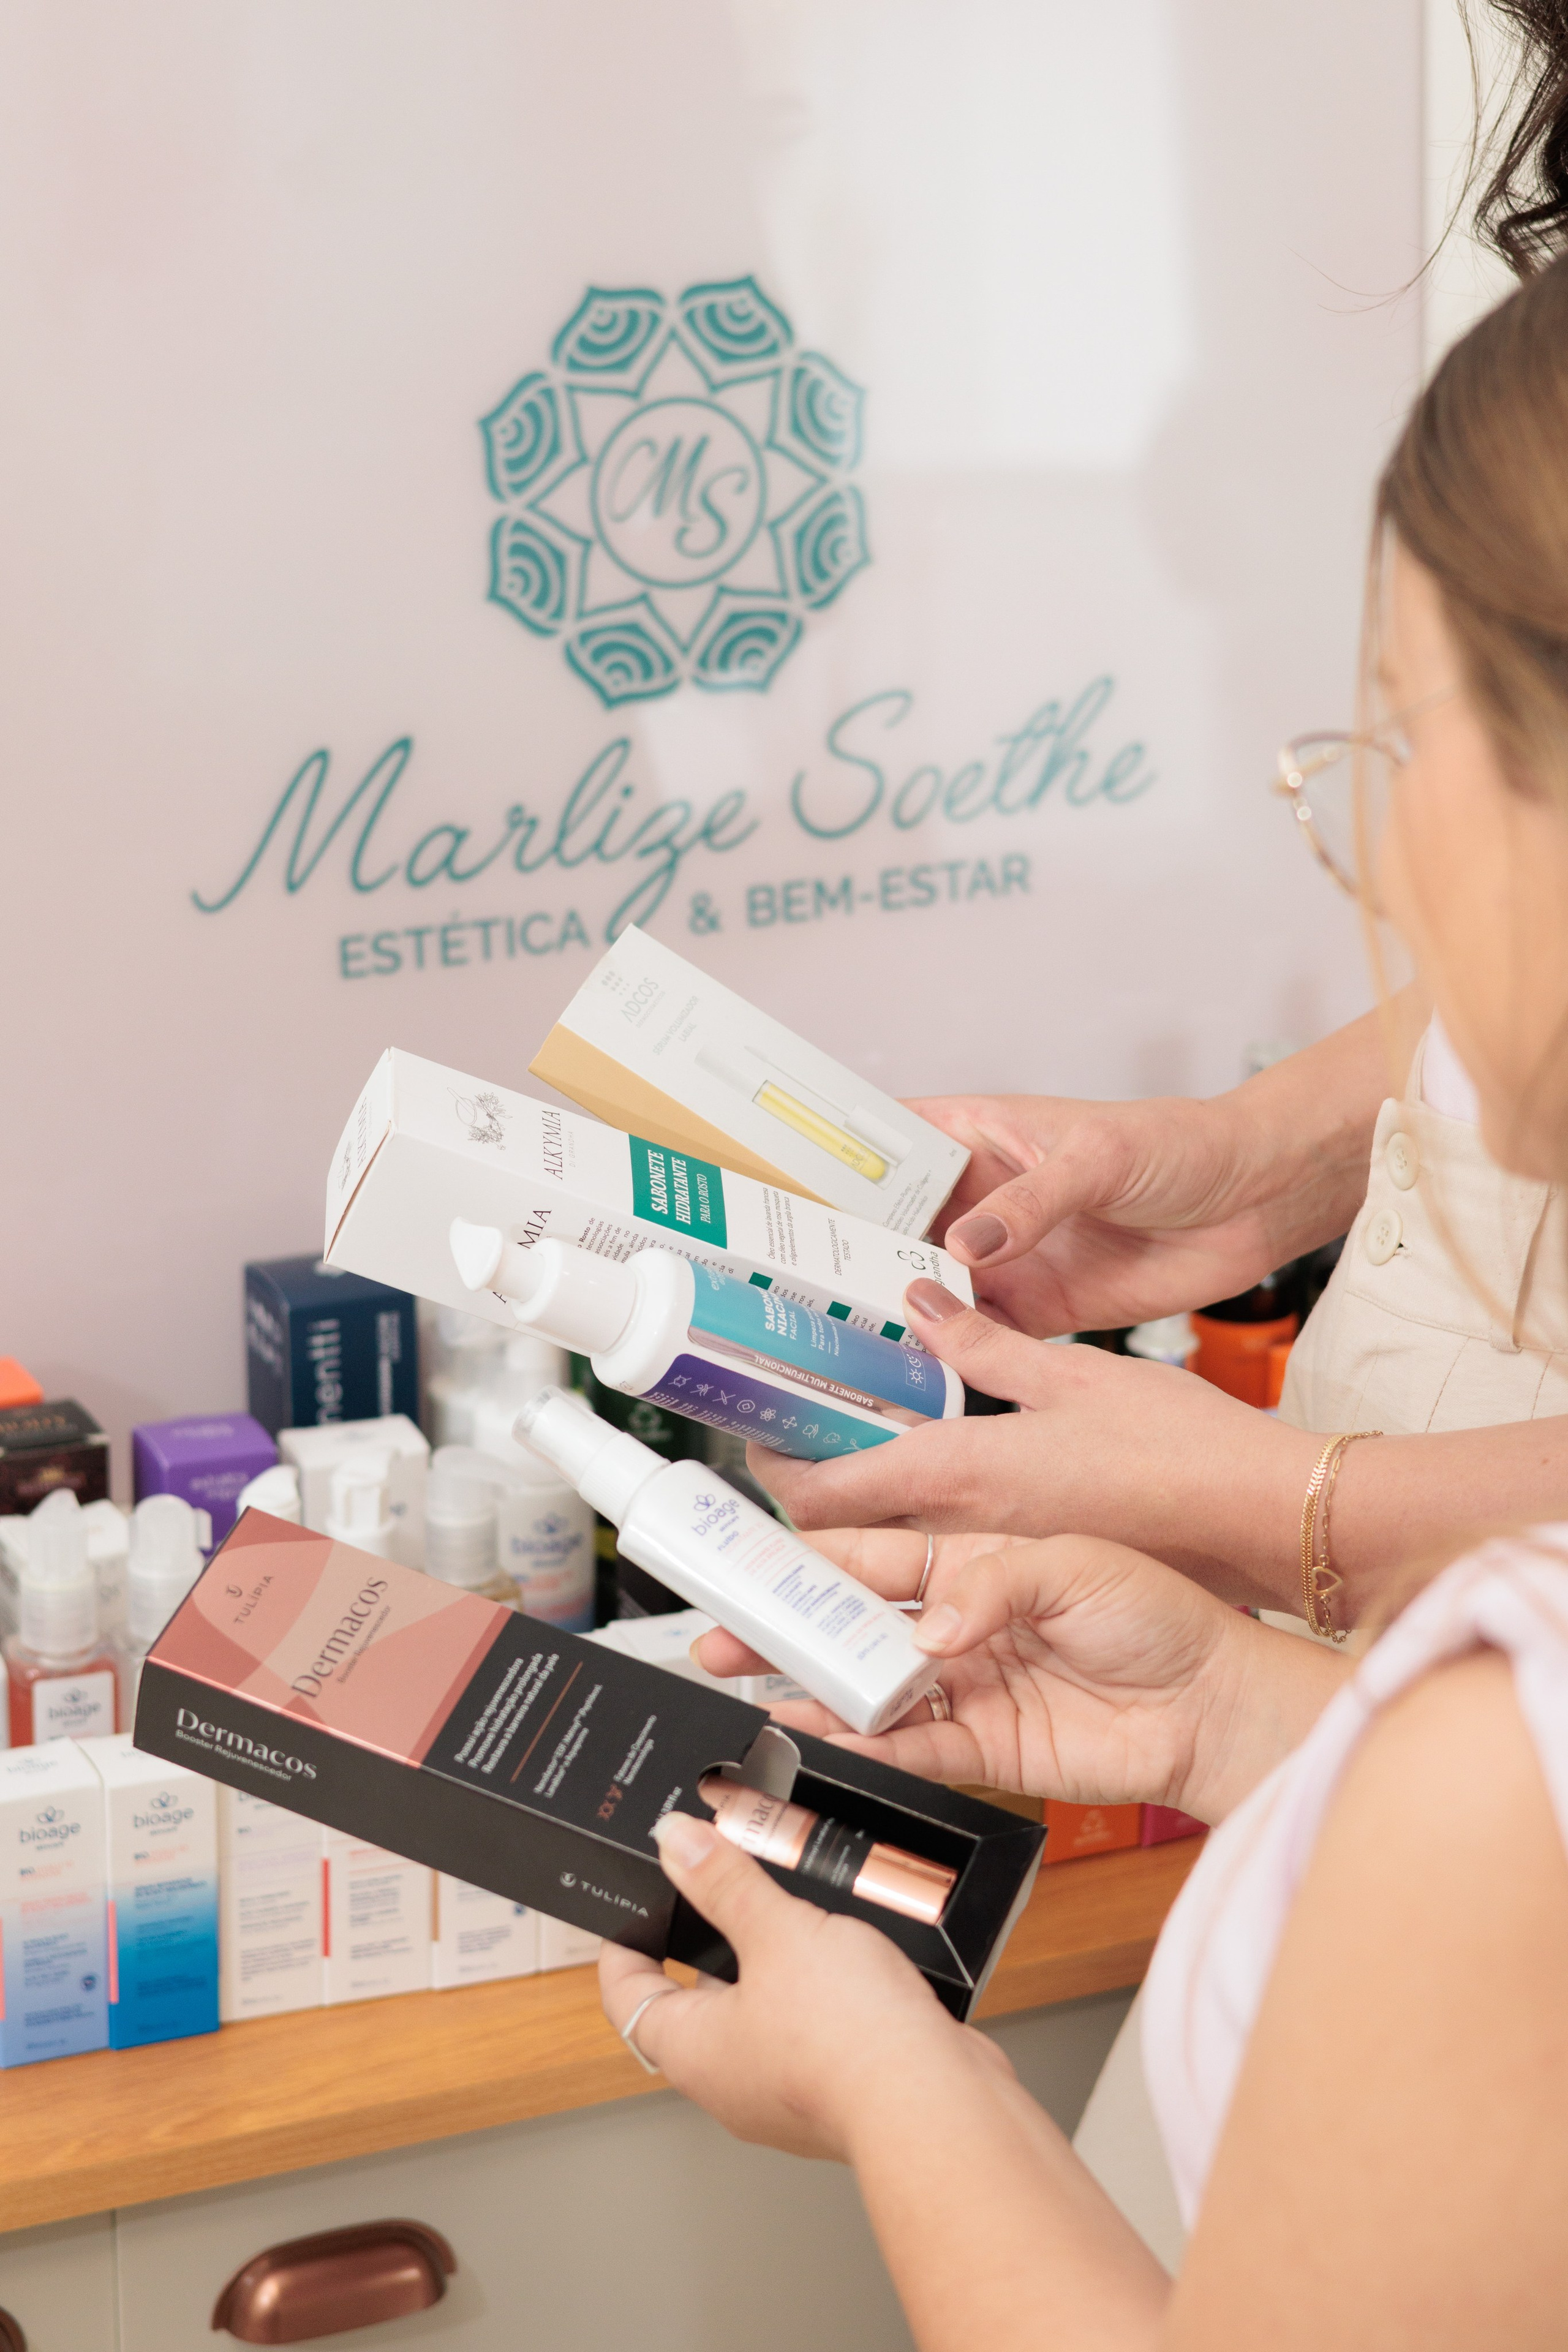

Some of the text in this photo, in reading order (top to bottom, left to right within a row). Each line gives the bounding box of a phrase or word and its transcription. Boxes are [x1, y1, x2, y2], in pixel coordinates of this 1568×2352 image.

[190, 676, 1160, 946] Marlize Soethe
[339, 852, 1033, 980] ESTÉTICA & BEM-ESTAR
[620, 977, 659, 1023] ADCOS
[652, 995, 700, 1056] SÉRUM VOLUMIZADOR
[677, 1022, 698, 1042] LABIAL
[541, 1110, 563, 1180] ALKYMIA
[570, 1159, 576, 1168] DI
[647, 1149, 668, 1215] SABONETE
[671, 1156, 691, 1225] HIDRATANTE
[696, 1174, 708, 1197] ROSTO
[900, 1194, 917, 1216] Volumizador
[916, 1172, 931, 1189] Colágeno
[699, 1204, 710, 1224] PARA
[764, 1204, 772, 1221] lavanda
[785, 1210, 794, 1223] argila
[882, 1208, 897, 1227] Complexo
[893, 1197, 904, 1210] Efeito
[900, 1186, 912, 1199] Plump
[905, 1216, 916, 1228] Ácido
[578, 1227, 591, 1243] Rosto
[585, 1221, 605, 1251] tecnologias
[595, 1224, 613, 1255] associações
[609, 1235, 618, 1245] fim
[624, 1230, 630, 1238] no
[628, 1233, 639, 1249] ainda
[766, 1226, 775, 1248] essencial
[788, 1228, 798, 1262] oligoelementos
[828, 1218, 842, 1276] DERMATOLOGICAMENTE
[842, 1240, 851, 1262] TESTADO
[766, 1247, 775, 1259] Óleo
[788, 1311, 797, 1340] FACIAL
[816, 1317, 824, 1333] todos
[752, 1354, 874, 1407] SABONETE MULTIFUNCIONAL
[691, 1497, 741, 1537] bioage
[291, 1577, 389, 1698] Dermacos
[337, 1605, 392, 1684] Booster Rejuvenescedor
[454, 1657, 524, 1763] Possui ação rejuvenescedora
[467, 1653, 543, 1768] Promove hidratação prolongada
[481, 1738, 509, 1774] Restaura
[505, 1704, 529, 1735] barreira
[523, 1678, 544, 1705] natural
[538, 1670, 550, 1681] da
[545, 1653, 559, 1672] pele
[176, 1708, 318, 1780] Dermacos
[630, 1714, 657, 1752] Crescimento
[176, 1728, 292, 1783] Booster Rejuvenescedor
[623, 1738, 654, 1785] Nanotecnologia
[20, 1822, 81, 1843] bioage
[134, 1807, 194, 1829] bioage
